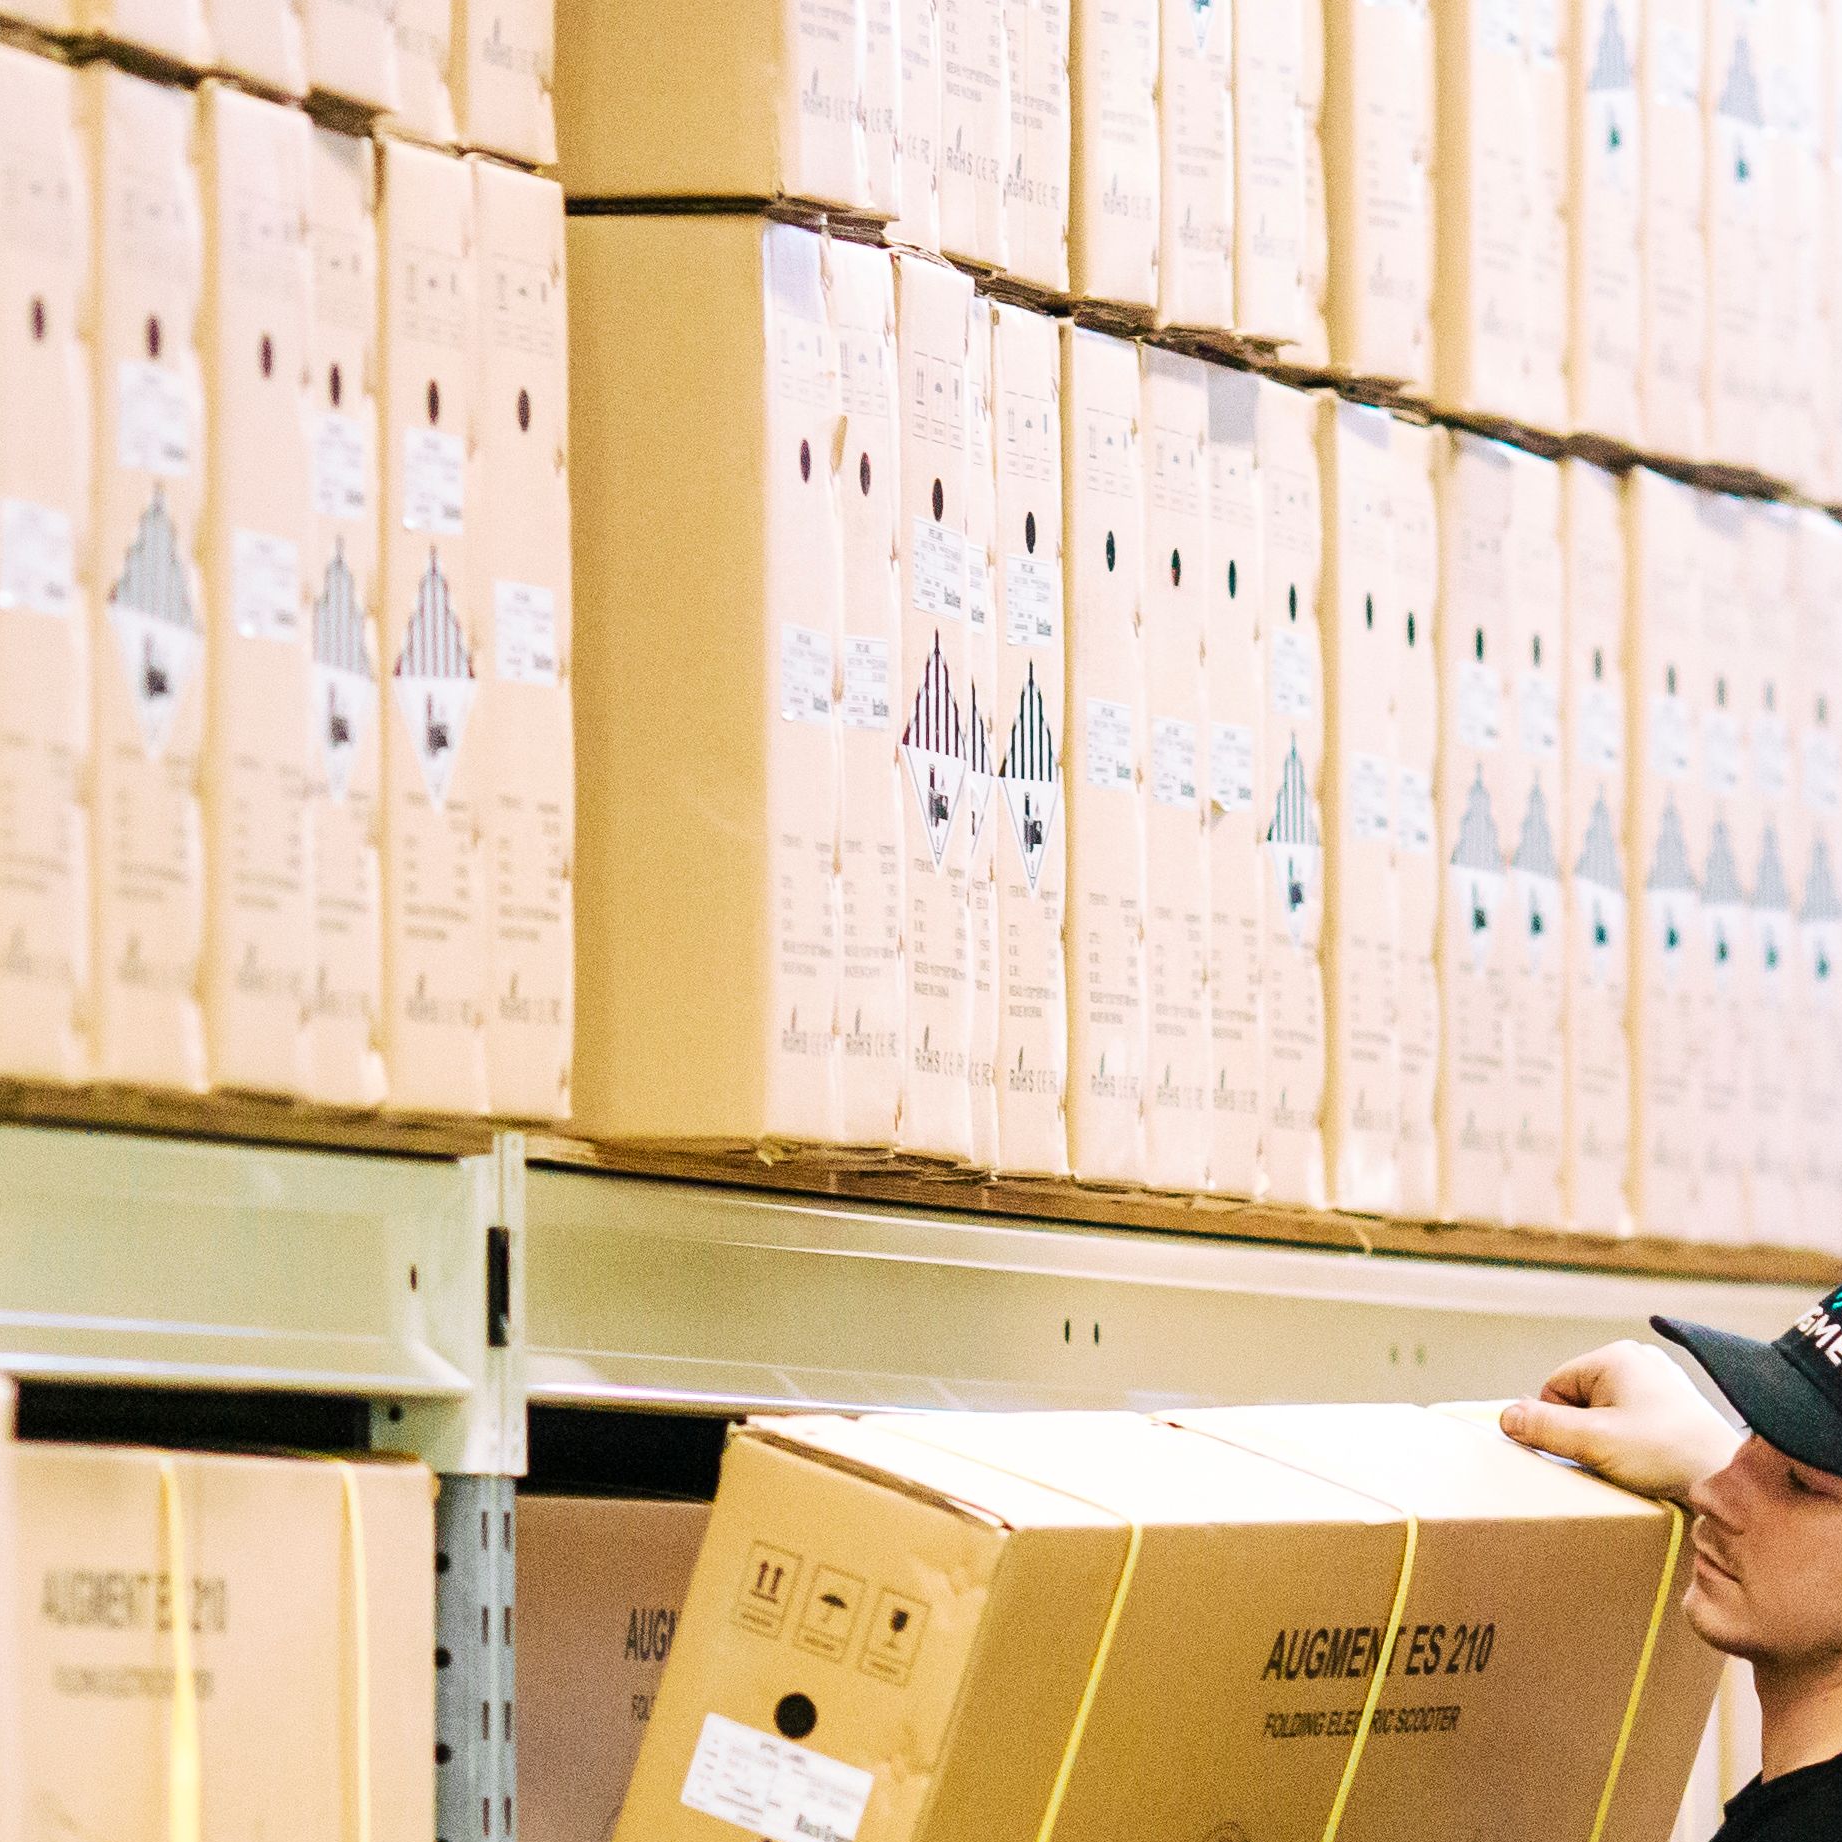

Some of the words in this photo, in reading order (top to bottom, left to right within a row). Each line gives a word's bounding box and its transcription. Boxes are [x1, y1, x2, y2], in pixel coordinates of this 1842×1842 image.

[1404, 1623, 1447, 1676] ES
[1443, 1621, 1496, 1675] 210
[1263, 1711, 1326, 1739] FOLDING
[1395, 1704, 1462, 1734] SCOOTER
